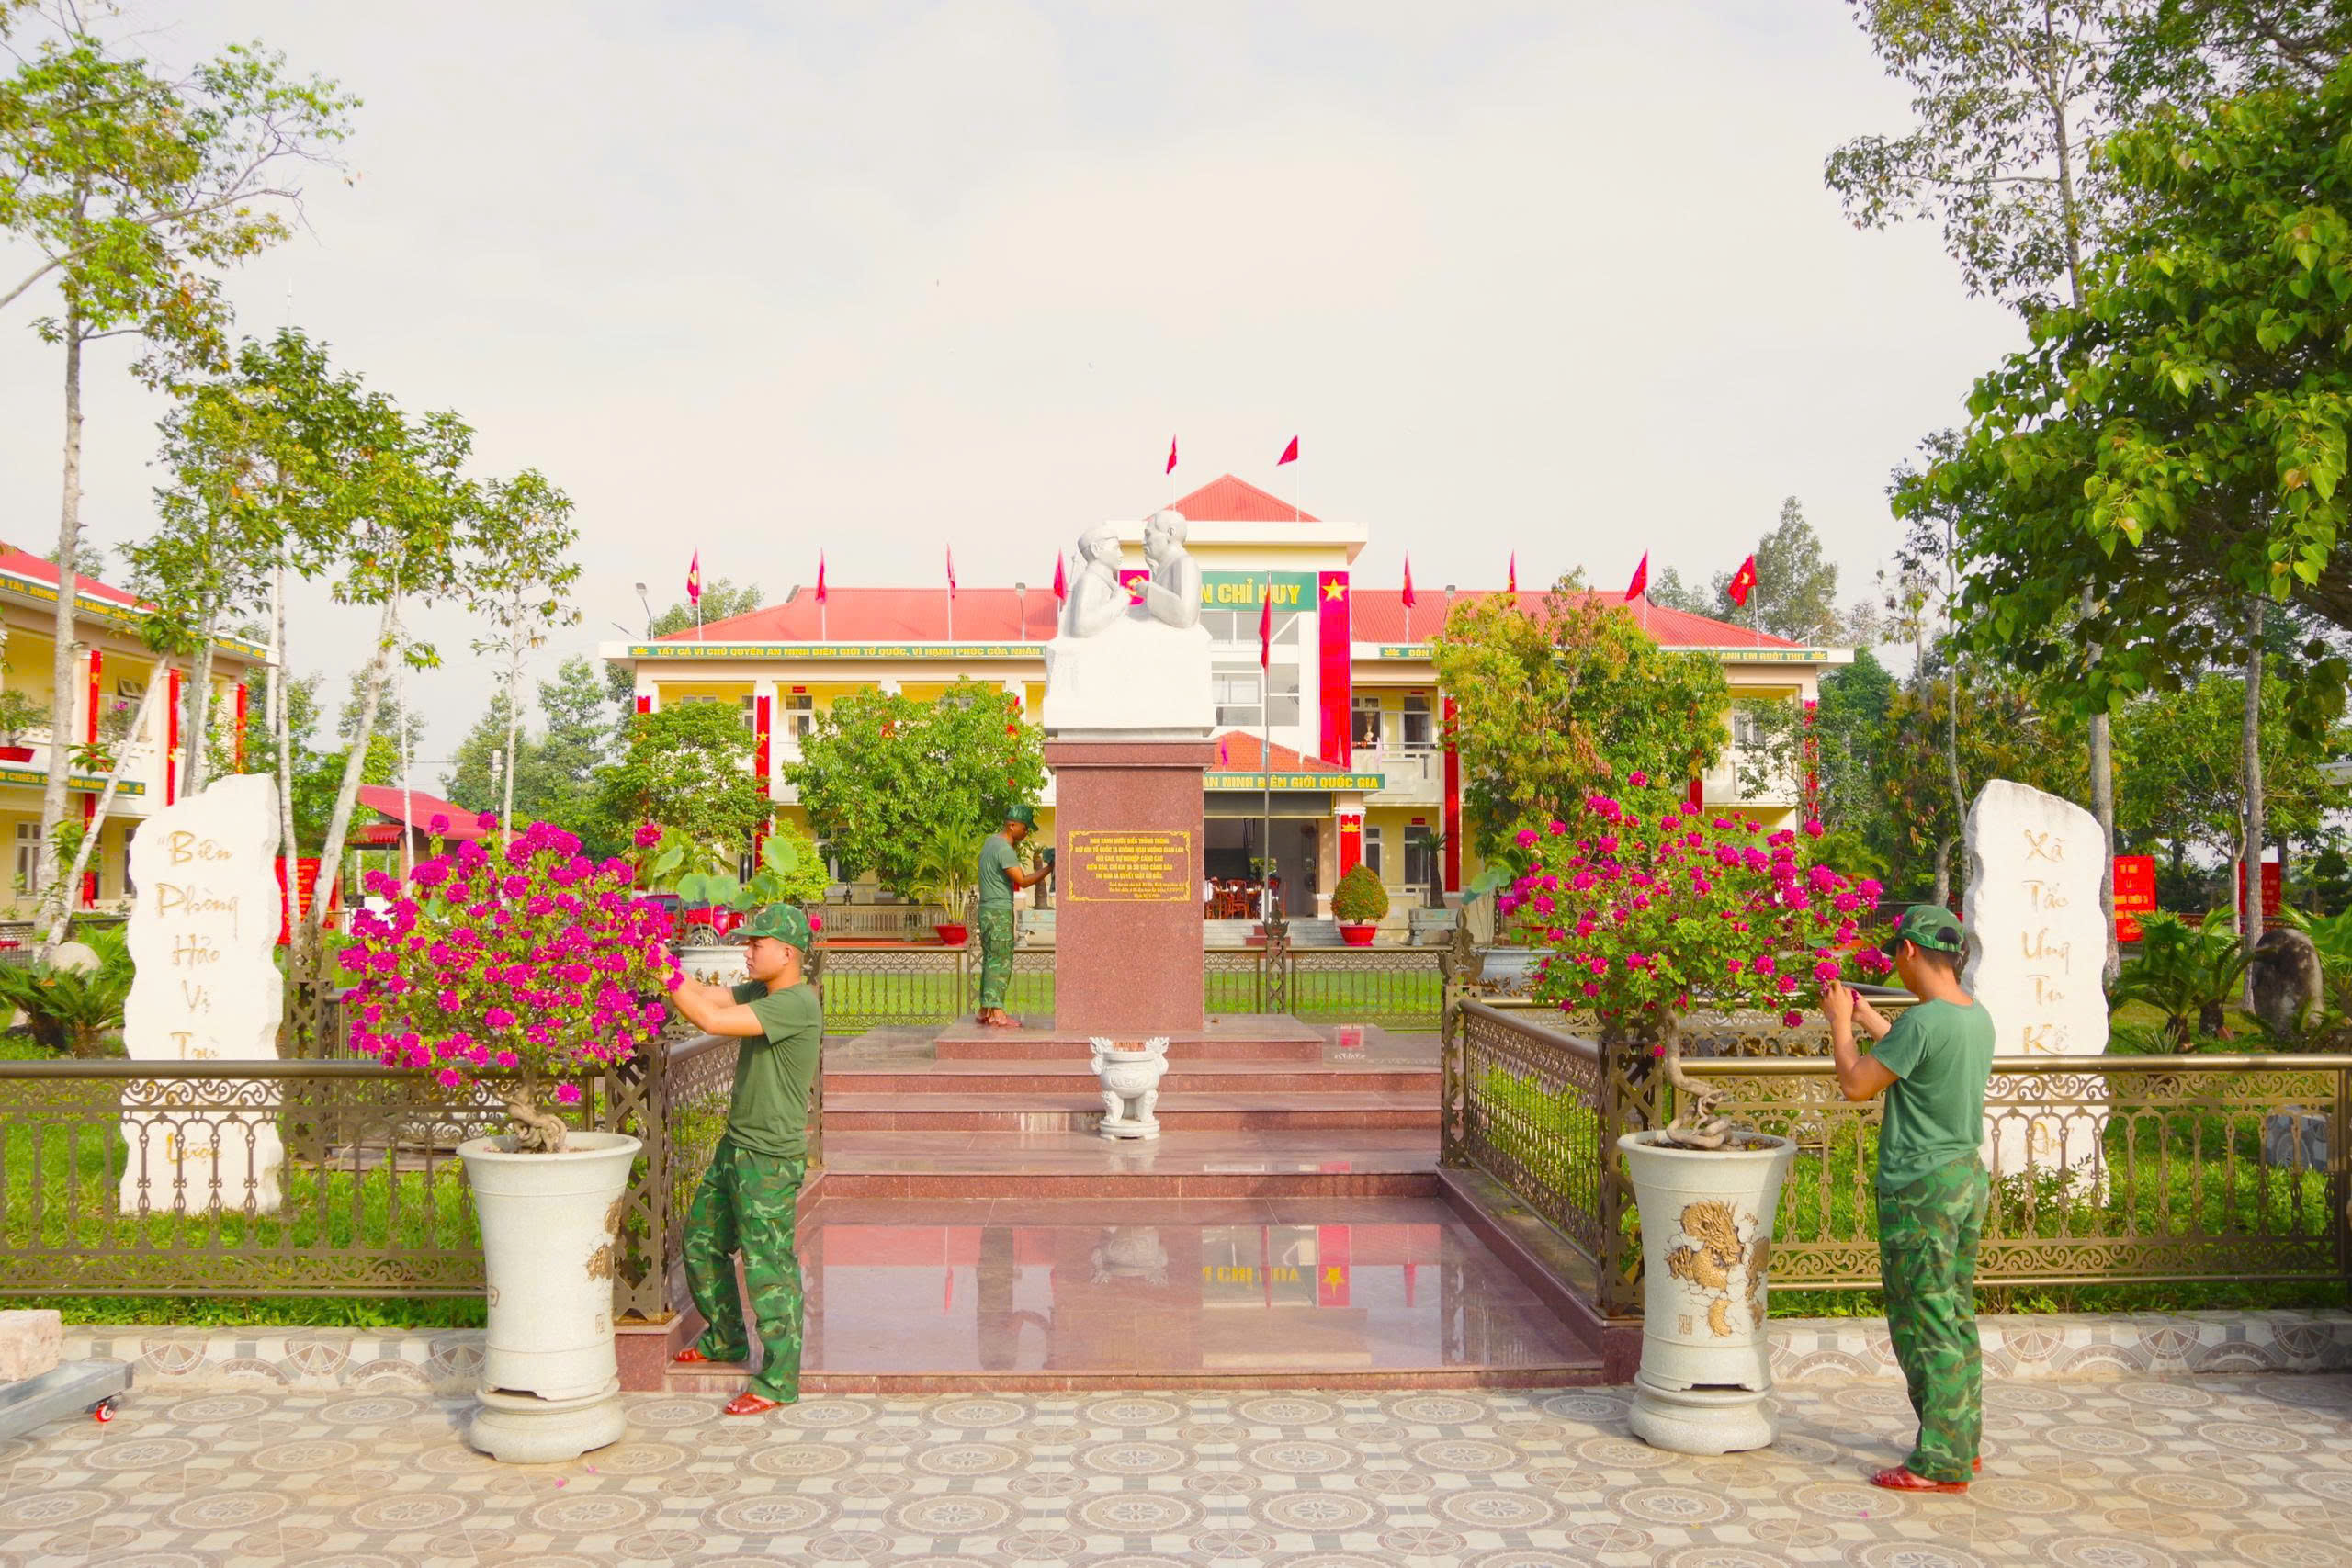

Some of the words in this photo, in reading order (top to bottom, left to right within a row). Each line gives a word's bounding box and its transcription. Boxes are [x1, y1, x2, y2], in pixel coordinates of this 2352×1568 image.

[1217, 578, 1253, 604] CHỈ
[766, 649, 781, 657] AN
[1721, 652, 1740, 660] ANH
[1743, 652, 1757, 660] EM
[1223, 777, 1253, 787] NINH
[1257, 774, 1286, 788] BÊN
[1290, 775, 1316, 788] GIỚI
[1319, 773, 1352, 788] QUỐC
[1357, 777, 1378, 788] GIA
[2023, 829, 2066, 862] Xã
[154, 882, 240, 942] Phòng
[172, 933, 220, 970] Hảo
[182, 979, 211, 1015] Vị
